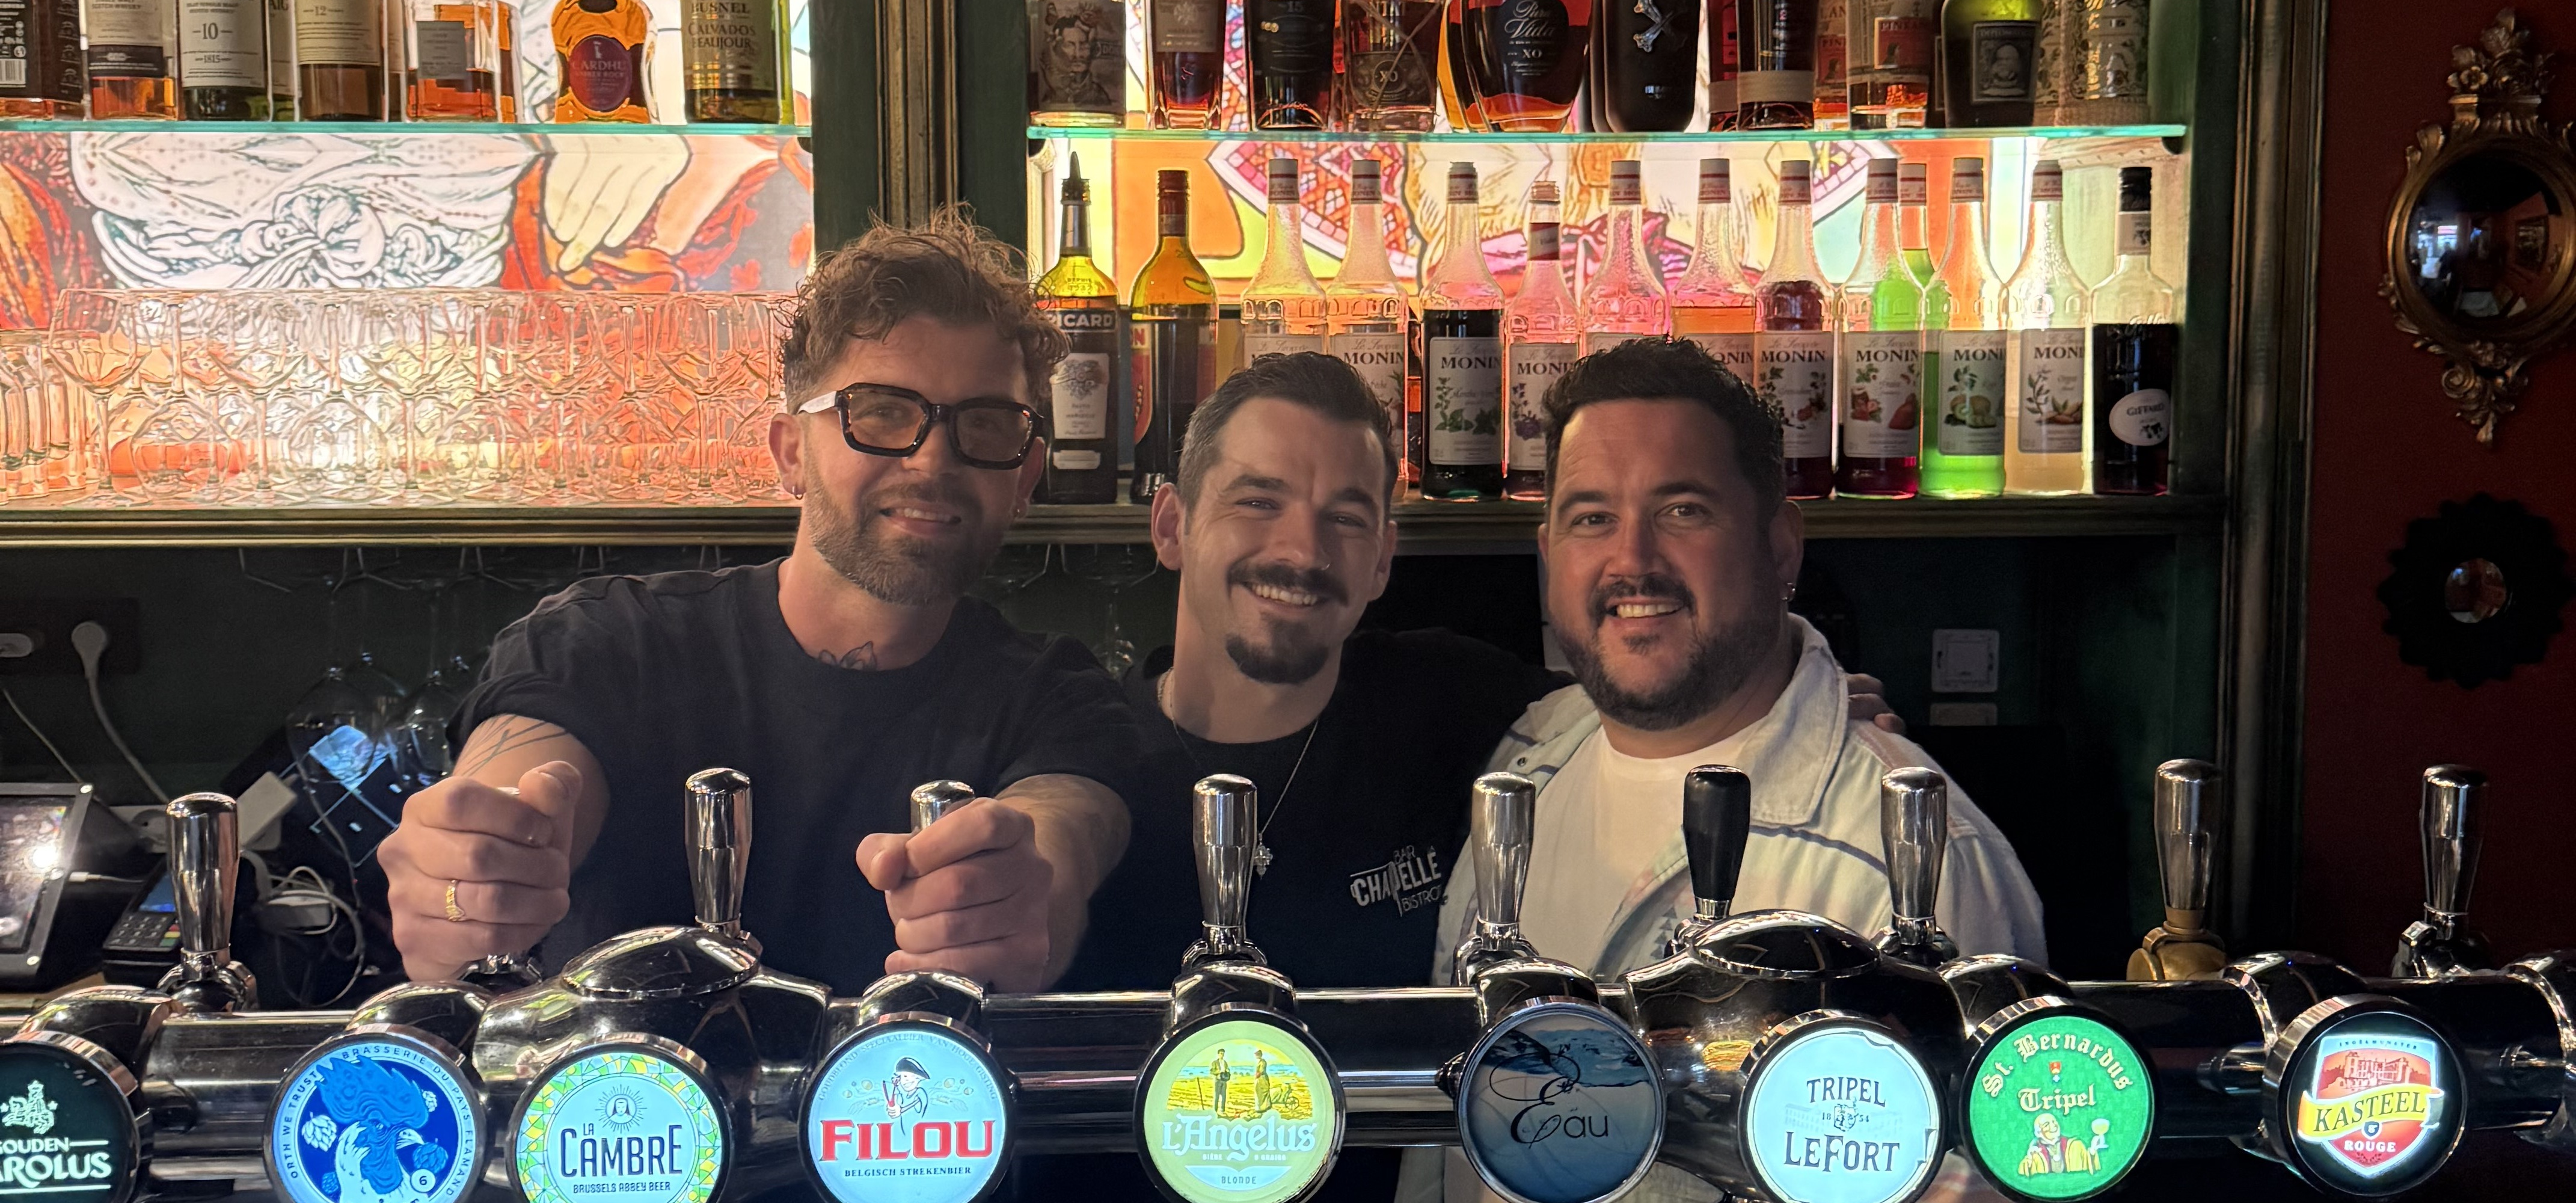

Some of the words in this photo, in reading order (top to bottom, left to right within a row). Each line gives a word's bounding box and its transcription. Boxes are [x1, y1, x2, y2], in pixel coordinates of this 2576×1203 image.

[314, 6, 327, 16] 12
[692, 2, 750, 13] BUSNEL
[202, 22, 218, 40] 10
[688, 20, 756, 36] CALVADOS
[1504, 18, 1556, 38] Vida
[1523, 49, 1542, 58] XO
[572, 61, 624, 70] CARDHU
[1344, 352, 1404, 365] MONIN
[1713, 352, 1753, 364] ONIN
[1761, 351, 1826, 362] MONIN
[1856, 350, 1919, 362] MONIN
[1954, 349, 2005, 361] MONI
[2035, 346, 2084, 359] MONI
[1518, 363, 1573, 375] MONI
[1351, 852, 1441, 906] CHAPELLE
[342, 1045, 426, 1065] BRASSERIE
[1982, 1061, 2014, 1098] St.
[2013, 1033, 2133, 1090] Bernardus
[433, 1066, 449, 1080] DU
[1806, 1076, 1886, 1107] TRIPEL
[283, 1116, 293, 1135] WE
[288, 1071, 317, 1109] TRUST
[452, 1087, 470, 1121] PAYS
[1489, 1052, 1609, 1149] Eau
[2017, 1083, 2097, 1115] Tripel
[2313, 1091, 2426, 1132] KASTEEL
[583, 1123, 594, 1136] LA
[819, 1119, 996, 1161] FILOU
[1162, 1113, 1317, 1161] L'Angelus
[0, 1137, 69, 1154] OUDEN
[560, 1124, 682, 1178] CAMBRE
[2344, 1140, 2396, 1152] ROUGE
[446, 1130, 473, 1195] FLAMAND
[845, 1168, 896, 1177] BELGISCH
[900, 1167, 972, 1176] STREKENBIER
[419, 1175, 428, 1186] 6
[1221, 1176, 1257, 1184] BLONDE
[573, 1183, 616, 1194] BRUSSELS
[619, 1182, 646, 1192] ABBEY
[649, 1182, 670, 1192] BEER
